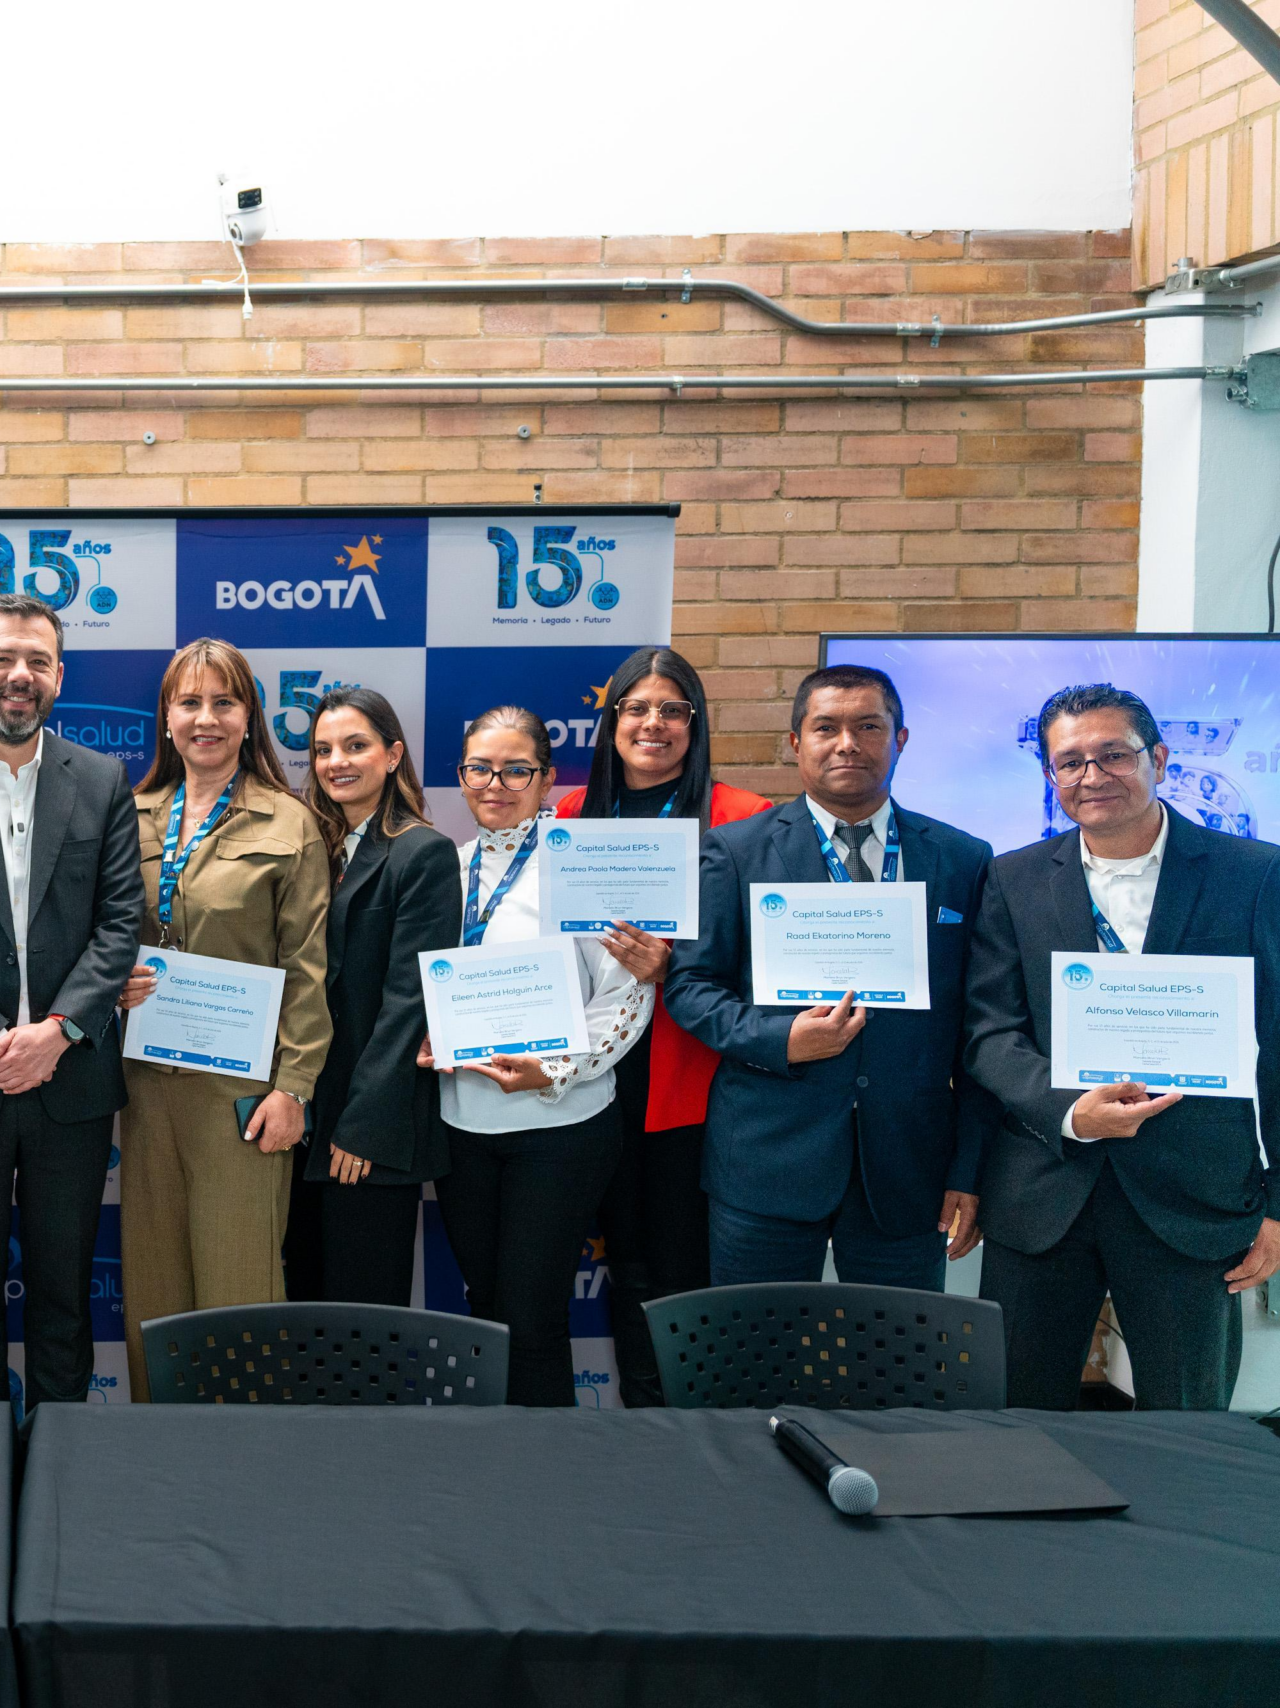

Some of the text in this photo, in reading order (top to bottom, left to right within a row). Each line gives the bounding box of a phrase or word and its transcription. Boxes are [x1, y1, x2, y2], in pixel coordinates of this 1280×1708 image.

[73, 540, 112, 554] años
[487, 526, 616, 609] 15 años
[83, 620, 110, 628] Futuro
[541, 617, 571, 626] Legado
[584, 616, 611, 624] Futuro
[289, 760, 310, 768] Lega
[576, 844, 660, 853] Capital Salud EPS-S
[792, 909, 884, 920] Capital Salud EPS-S
[786, 932, 810, 940] Raad
[459, 971, 488, 981] Capital
[489, 967, 512, 977] Salud
[513, 964, 539, 974] EPS-S
[1068, 969, 1084, 982] 15
[170, 976, 197, 989] Capital
[198, 980, 221, 991] Salud
[221, 984, 247, 995] EPS-S
[1099, 983, 1204, 995] Capital Salud EPS-S
[451, 993, 476, 1002] Eileen
[477, 989, 501, 999] Astrid
[534, 983, 553, 992] Arce
[156, 994, 180, 1004] Sandra
[181, 998, 203, 1007] Liliana
[203, 1001, 227, 1012] Vargas
[1085, 1006, 1124, 1016] Alfonso
[1125, 1007, 1165, 1017] Velasco
[89, 1374, 117, 1388] ños
